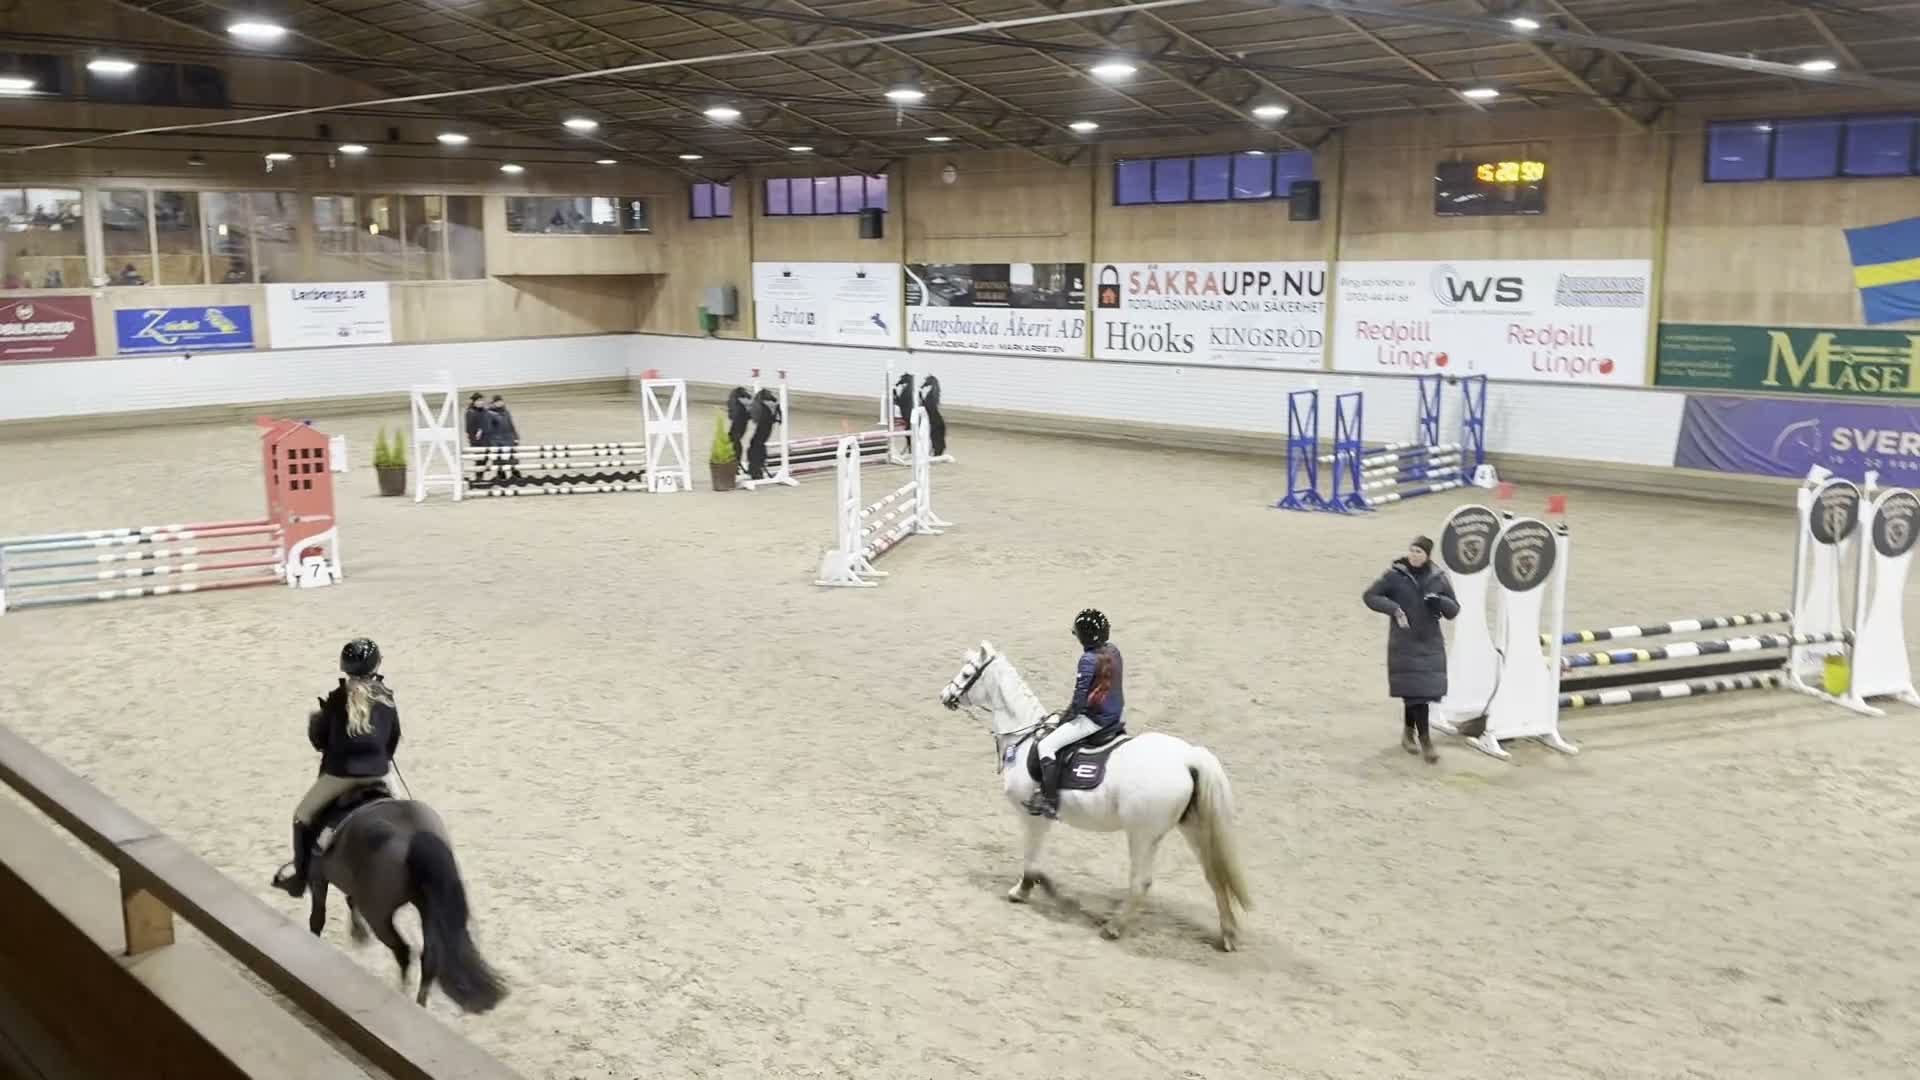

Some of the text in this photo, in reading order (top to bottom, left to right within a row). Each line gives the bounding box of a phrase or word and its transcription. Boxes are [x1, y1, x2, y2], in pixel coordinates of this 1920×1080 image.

[1127, 264, 1326, 297] SÄKRAUPP.NU
[1447, 277, 1524, 303] WS
[1127, 298, 1325, 313] TOTALLÖSNINGAR INOM SÄKERHET
[909, 309, 1086, 339] Kungsbacka Åkeri AB
[1104, 321, 1324, 353] Hööks KINGSRÖD
[1355, 320, 1432, 343] Redpill
[1506, 322, 1595, 350] Redpill
[311, 563, 321, 579] 7
